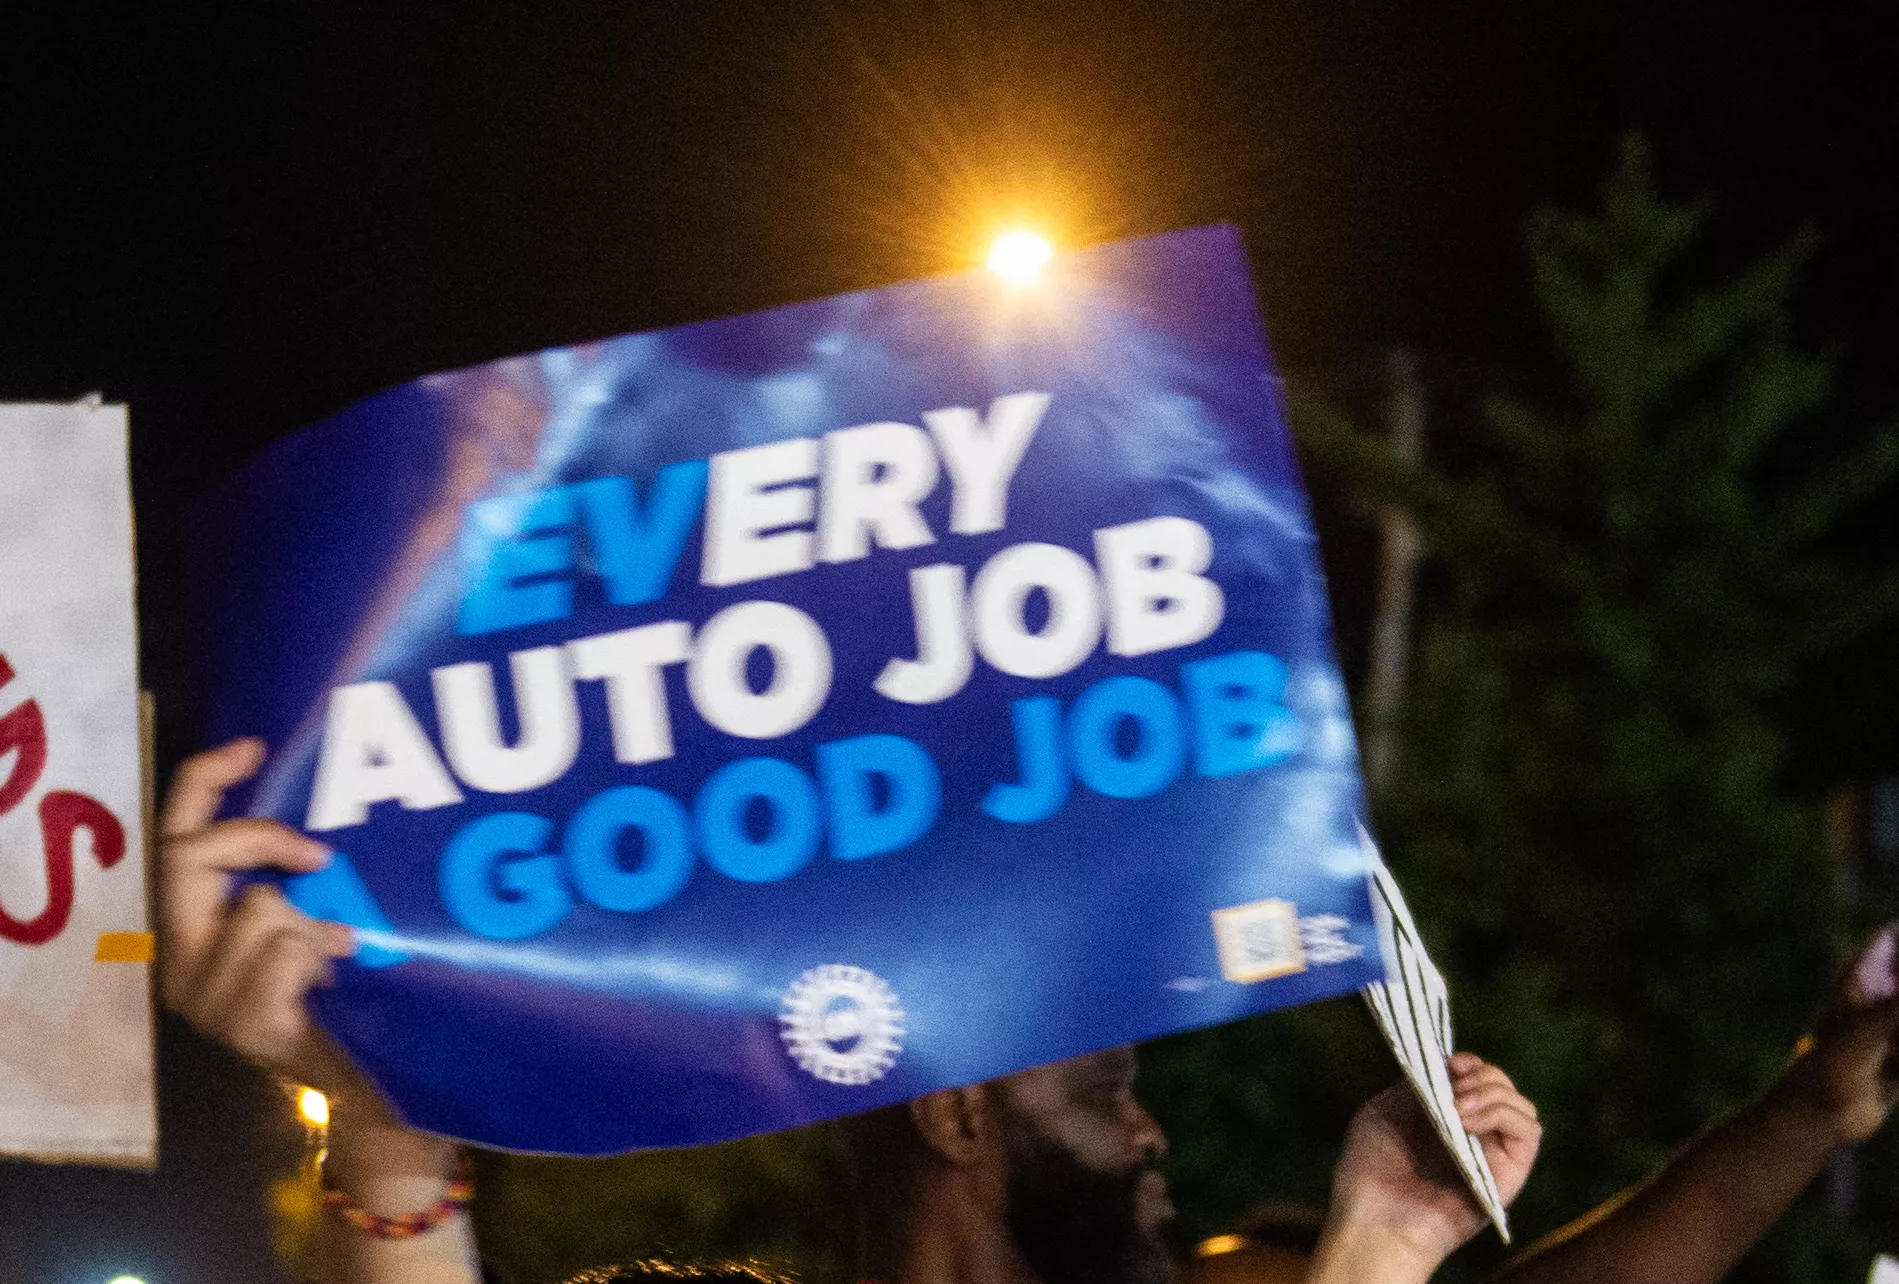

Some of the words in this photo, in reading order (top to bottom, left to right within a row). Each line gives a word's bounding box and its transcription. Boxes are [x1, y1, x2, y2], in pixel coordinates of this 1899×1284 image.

[455, 393, 1051, 635] EVERY
[305, 600, 833, 830] AUTO
[872, 515, 1226, 705] JOB
[437, 732, 942, 940] GOOD
[980, 650, 1303, 824] JOB
